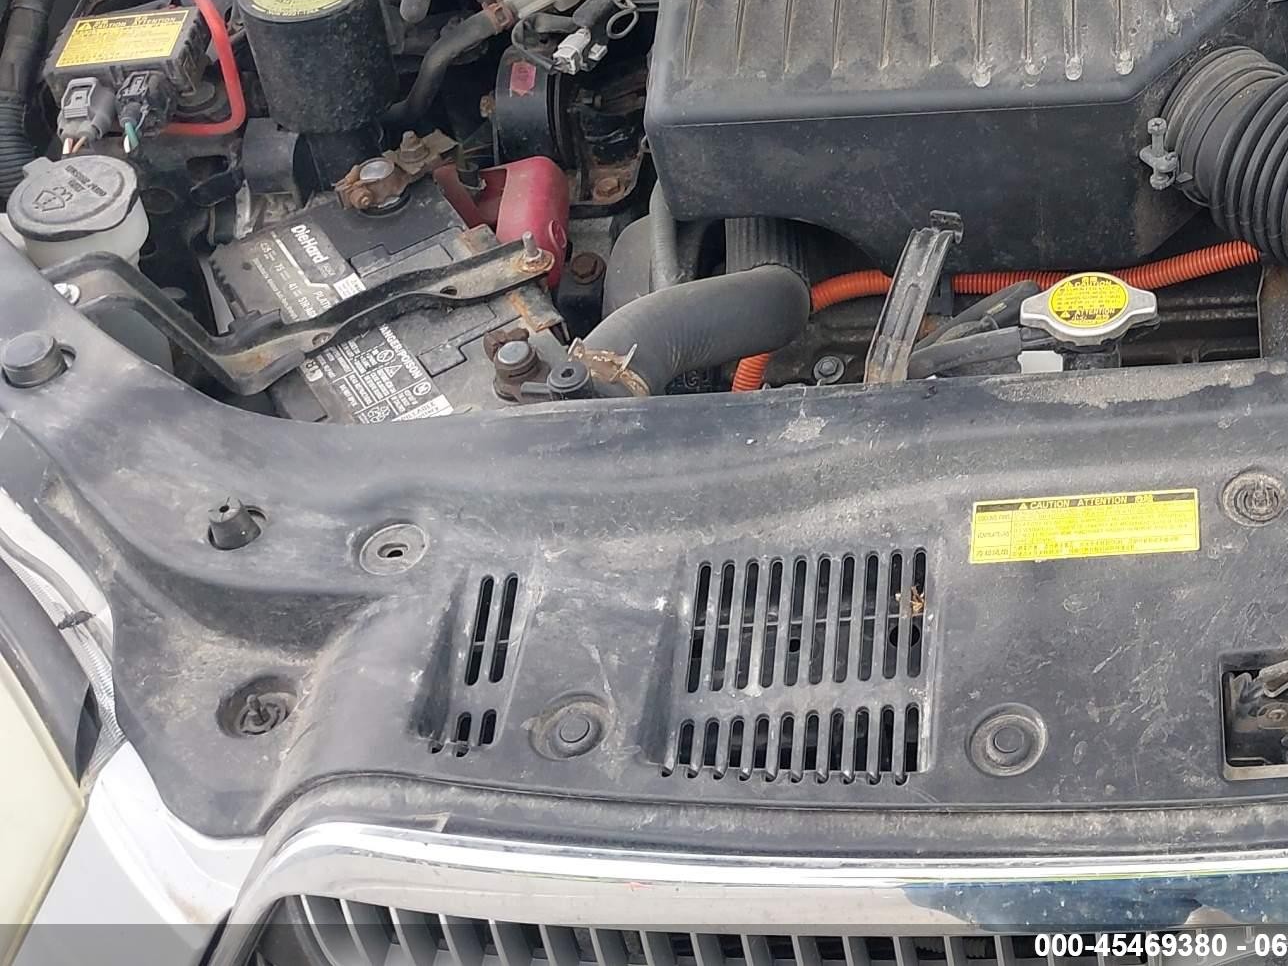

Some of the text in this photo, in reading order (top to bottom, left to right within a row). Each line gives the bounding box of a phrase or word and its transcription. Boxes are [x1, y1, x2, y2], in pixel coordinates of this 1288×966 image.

[290, 224, 331, 265] DieHard
[1029, 499, 1071, 510] CAUTION
[1077, 495, 1128, 507] ATTENTION
